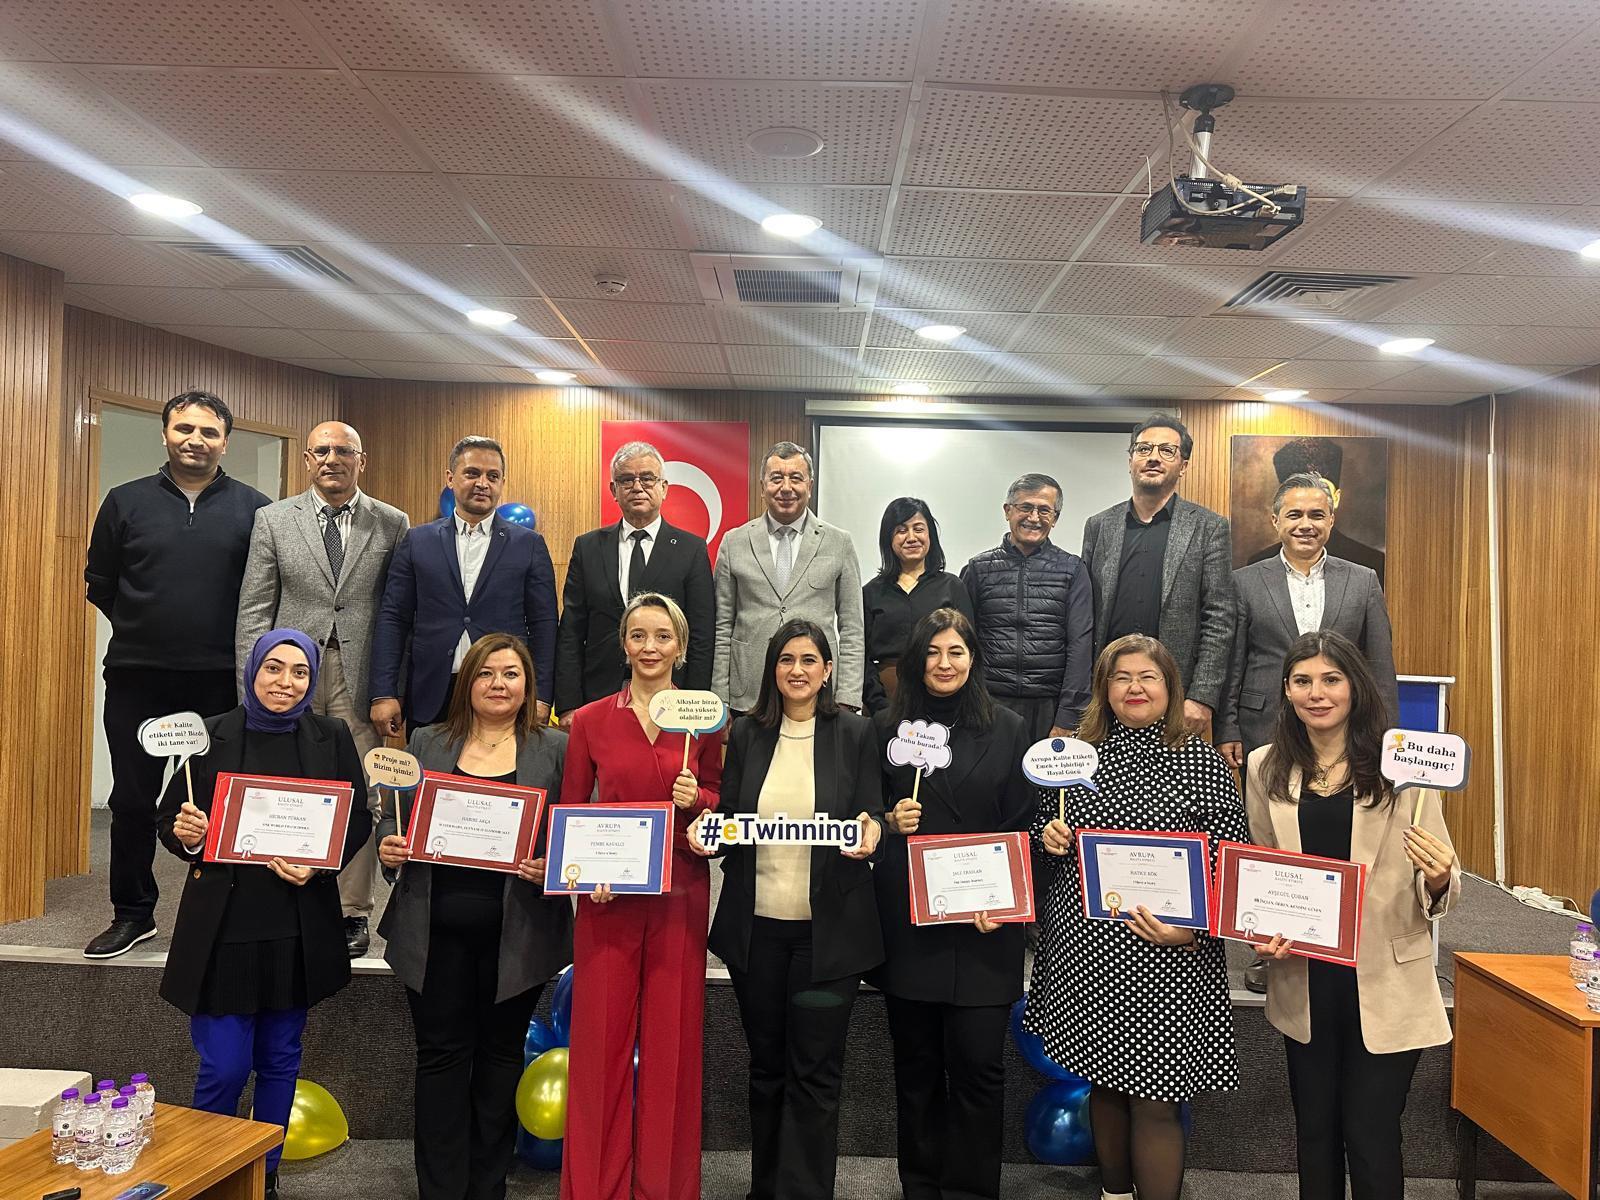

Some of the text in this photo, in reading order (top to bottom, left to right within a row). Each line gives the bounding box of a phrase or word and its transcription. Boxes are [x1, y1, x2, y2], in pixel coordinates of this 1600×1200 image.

[149, 731, 174, 739] etiketi
[916, 732, 936, 741] Takım
[900, 737, 942, 750] ruhu burada!
[1407, 741, 1456, 758] Bu daha
[381, 755, 398, 765] Proje
[1393, 752, 1455, 772] başlangıç!
[373, 762, 414, 777] Bizim işimiz!
[700, 816, 858, 848] #eTwinning
[1274, 870, 1304, 880] ULUSAL
